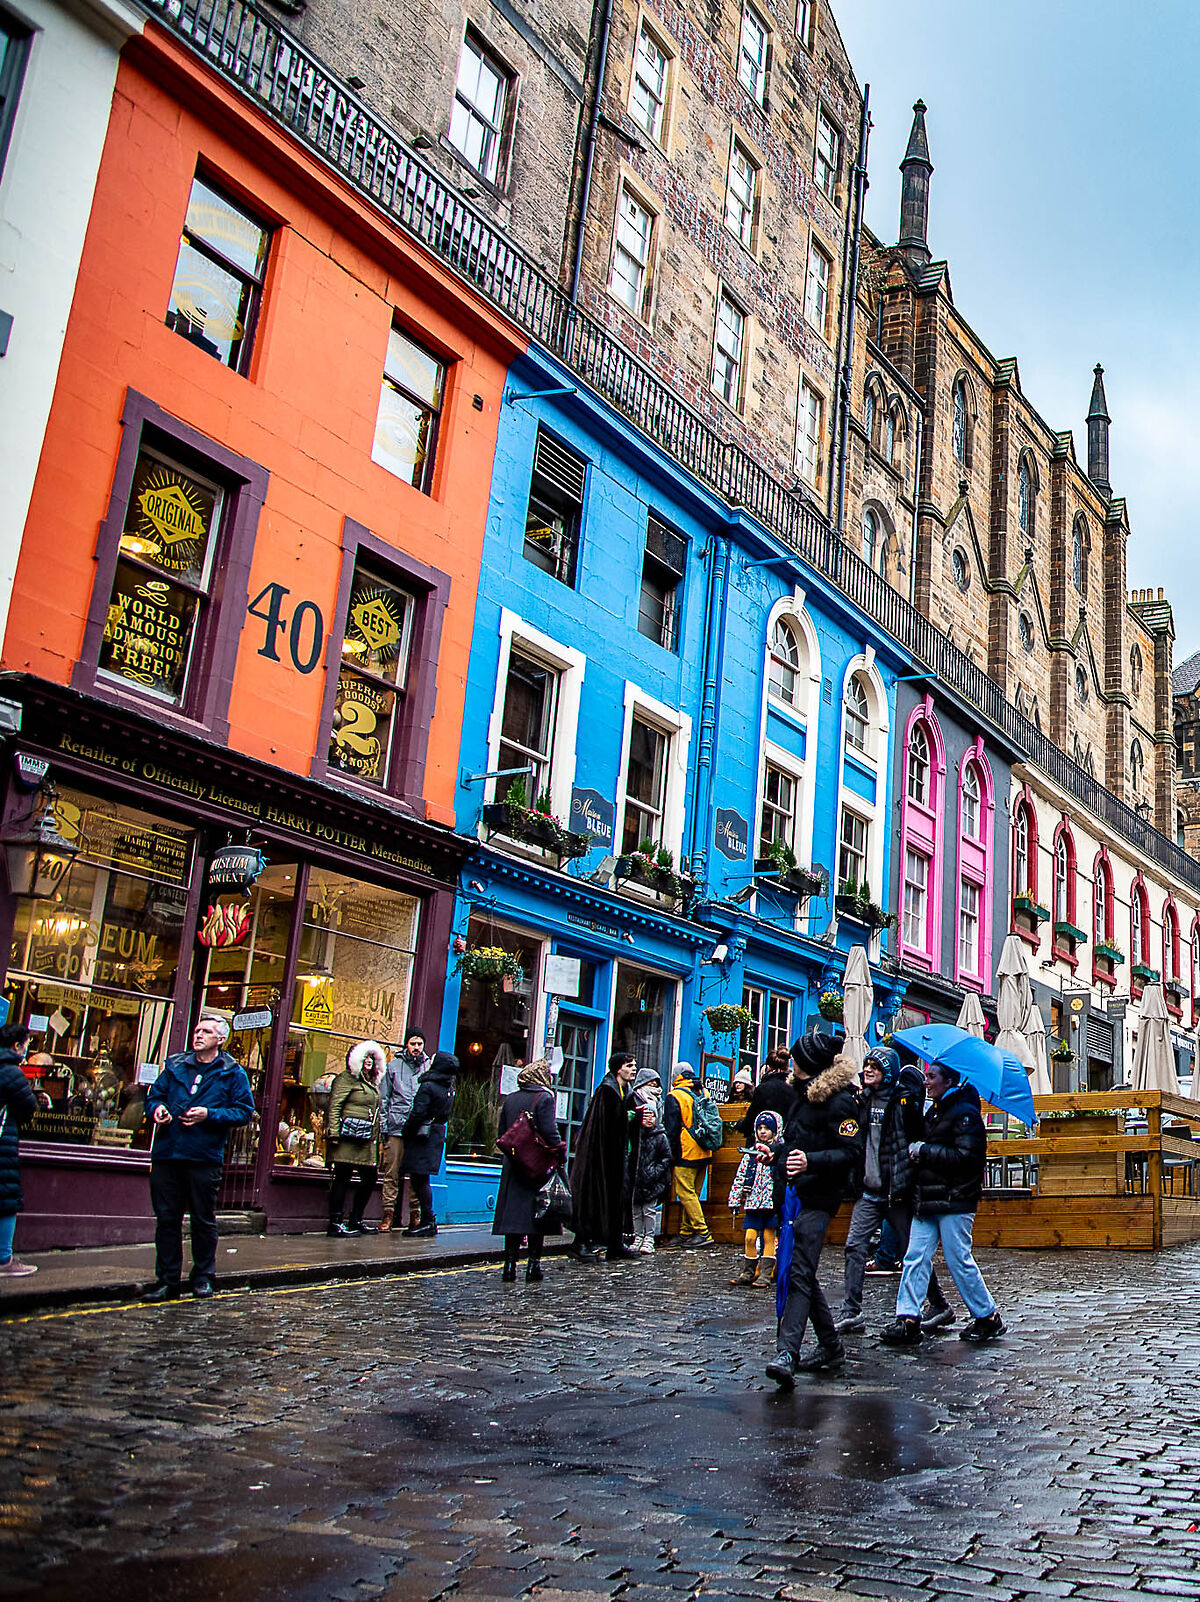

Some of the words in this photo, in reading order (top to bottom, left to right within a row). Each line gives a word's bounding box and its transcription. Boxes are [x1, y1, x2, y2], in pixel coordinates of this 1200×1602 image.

[147, 494, 196, 534] ORIGINAL
[118, 592, 180, 629] WORLD
[362, 610, 392, 637] BEST
[108, 607, 183, 648] FAMOUS!
[248, 582, 323, 674] 40
[103, 623, 184, 664] ADMISSION
[111, 643, 171, 678] FREE!
[336, 746, 347, 761] TO
[60, 733, 119, 767] Retailer
[122, 758, 136, 773] of
[142, 763, 206, 801] Officially
[209, 786, 261, 816] Licensed
[266, 808, 314, 833] HARRY
[315, 823, 366, 852] POTTER
[577, 799, 602, 820] Maison
[586, 816, 612, 839] BLEUE
[721, 820, 740, 839] Maison
[124, 835, 152, 848] HARRY
[155, 840, 186, 859] POTTER
[727, 835, 748, 855] BLEUE
[40, 859, 63, 880] 40
[38, 917, 158, 964] MUSEUM
[57, 952, 129, 984] CONTEXT
[89, 993, 116, 1008] POTTER
[305, 1012, 330, 1020] CAUTION
